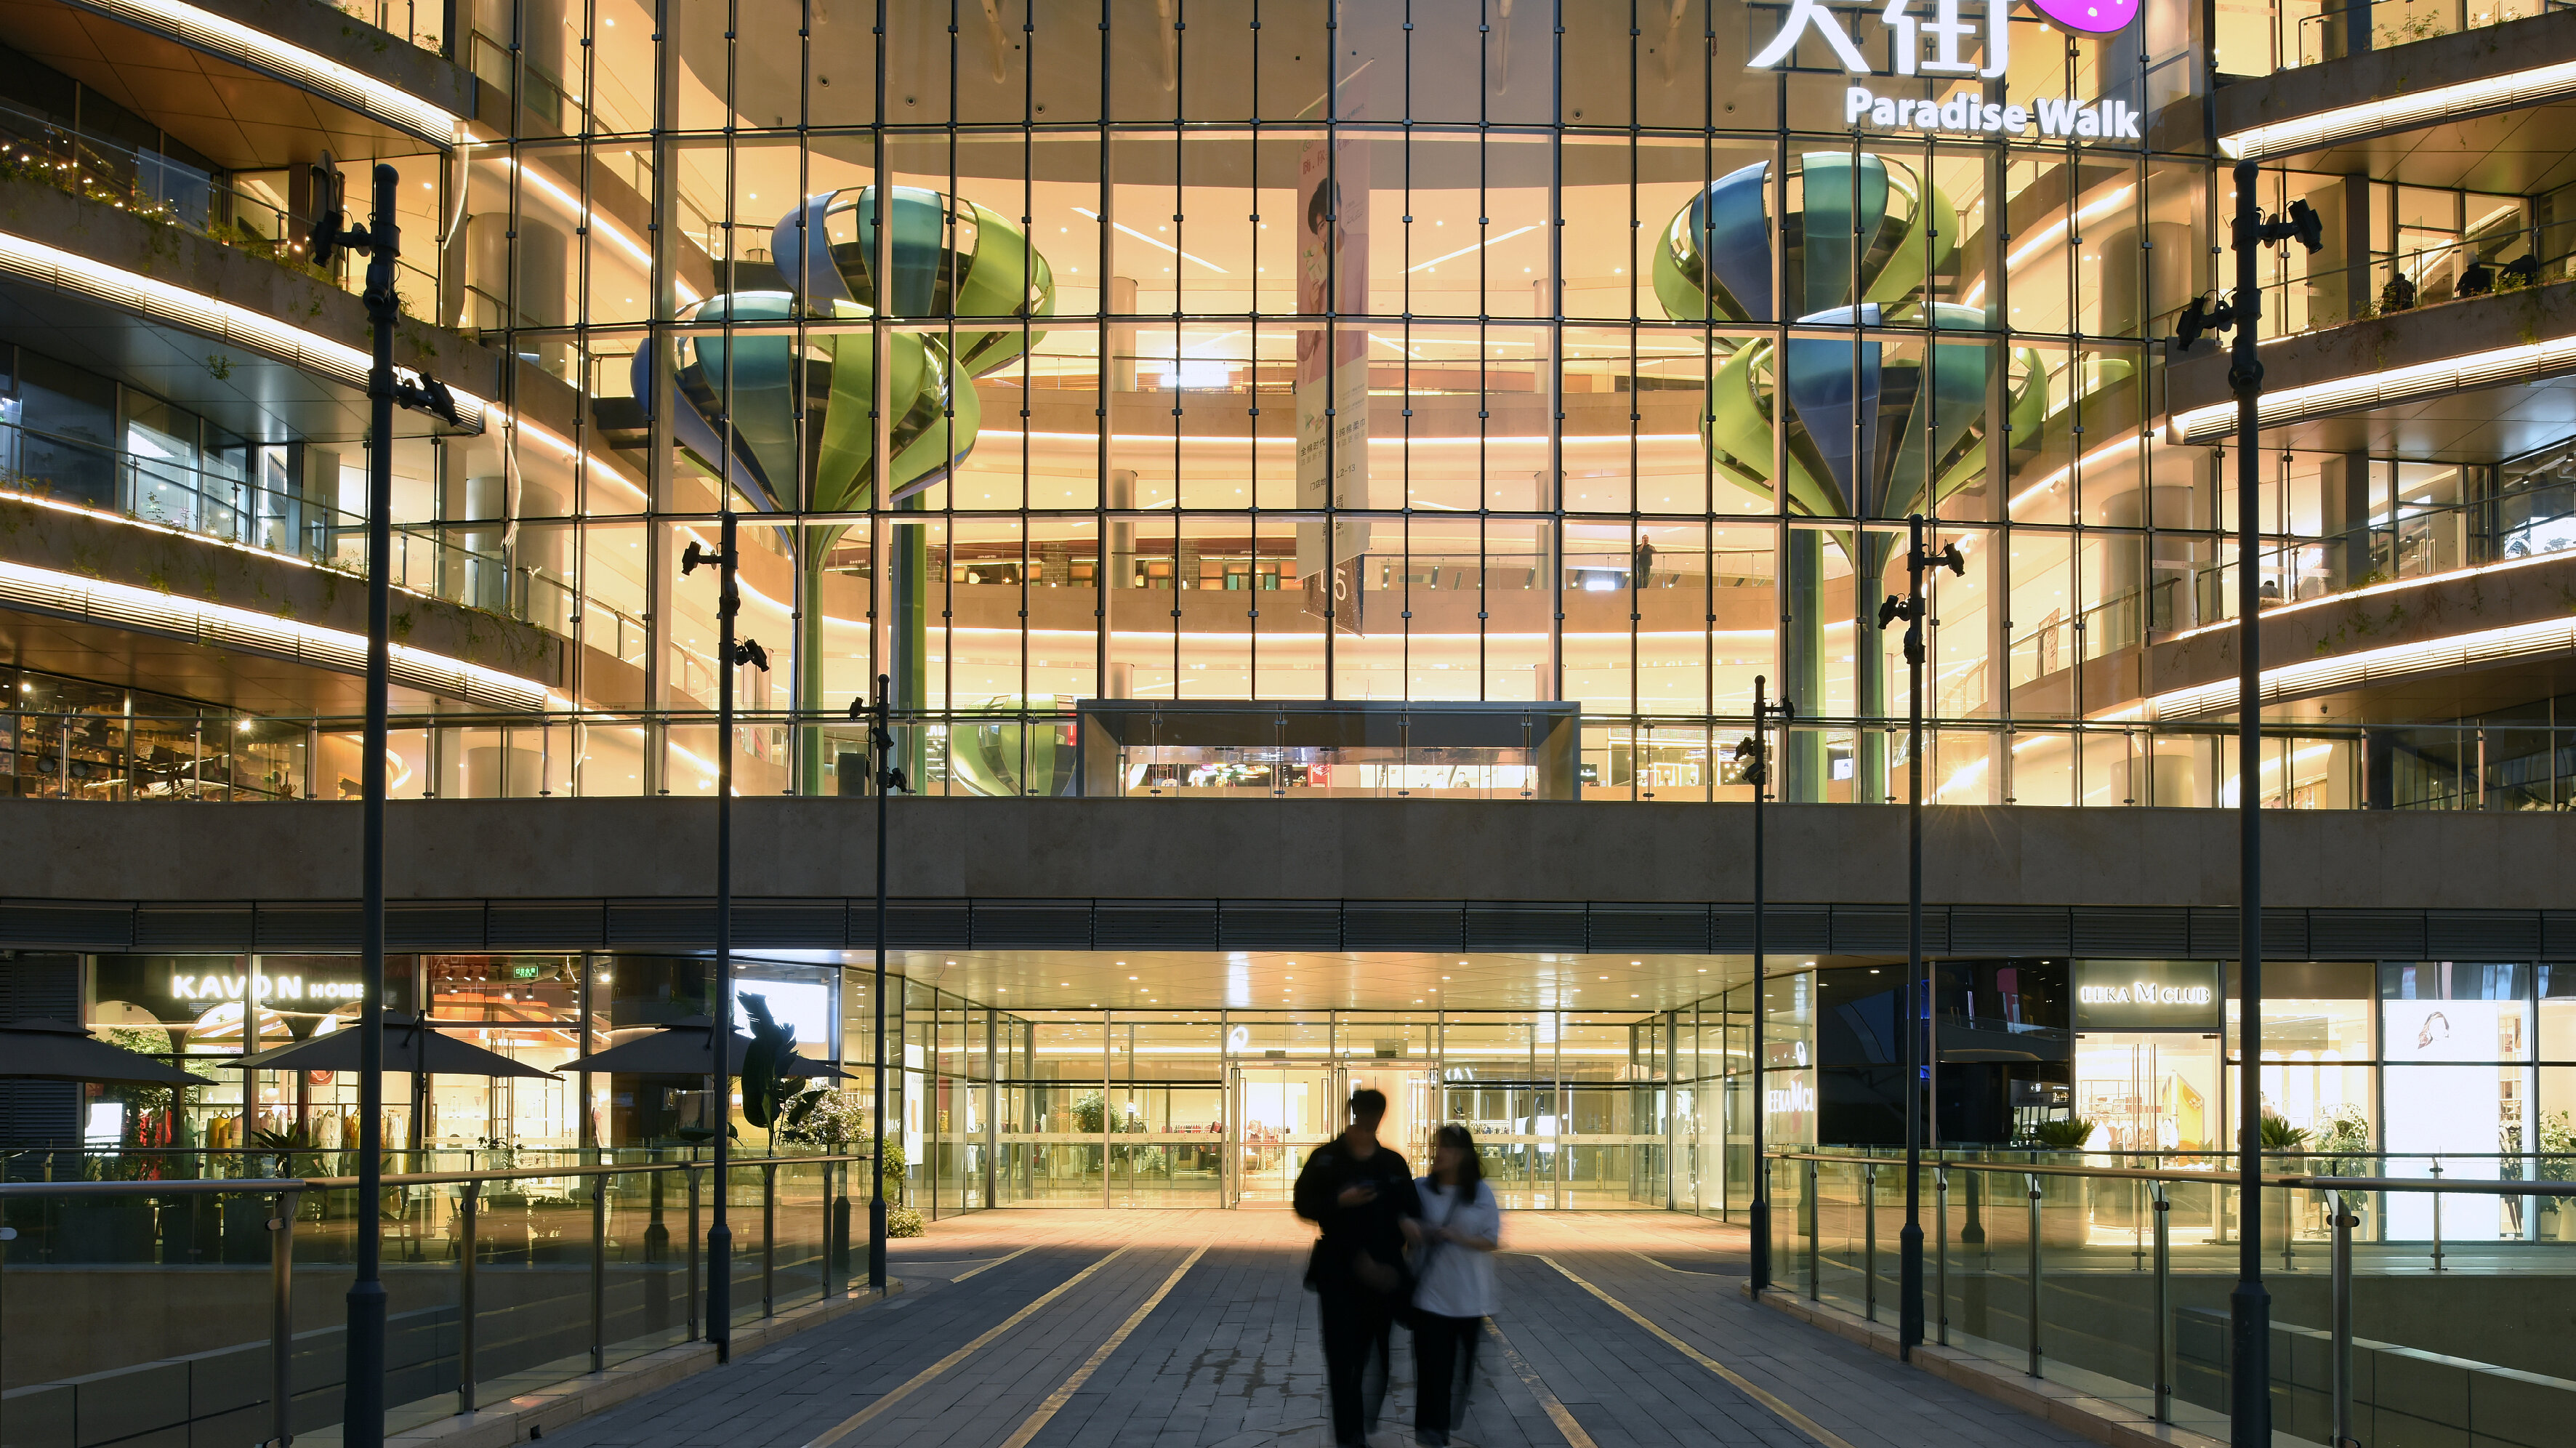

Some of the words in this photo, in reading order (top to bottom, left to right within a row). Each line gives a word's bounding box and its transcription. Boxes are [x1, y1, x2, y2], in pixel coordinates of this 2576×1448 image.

[1846, 87, 2026, 133] Paradise
[2035, 97, 2141, 139] Walk
[173, 976, 302, 999] KAVON
[310, 984, 363, 998] HOME
[2082, 986, 2131, 1003] EEKA
[2134, 982, 2157, 1002] M
[2162, 986, 2210, 1003] CLUB
